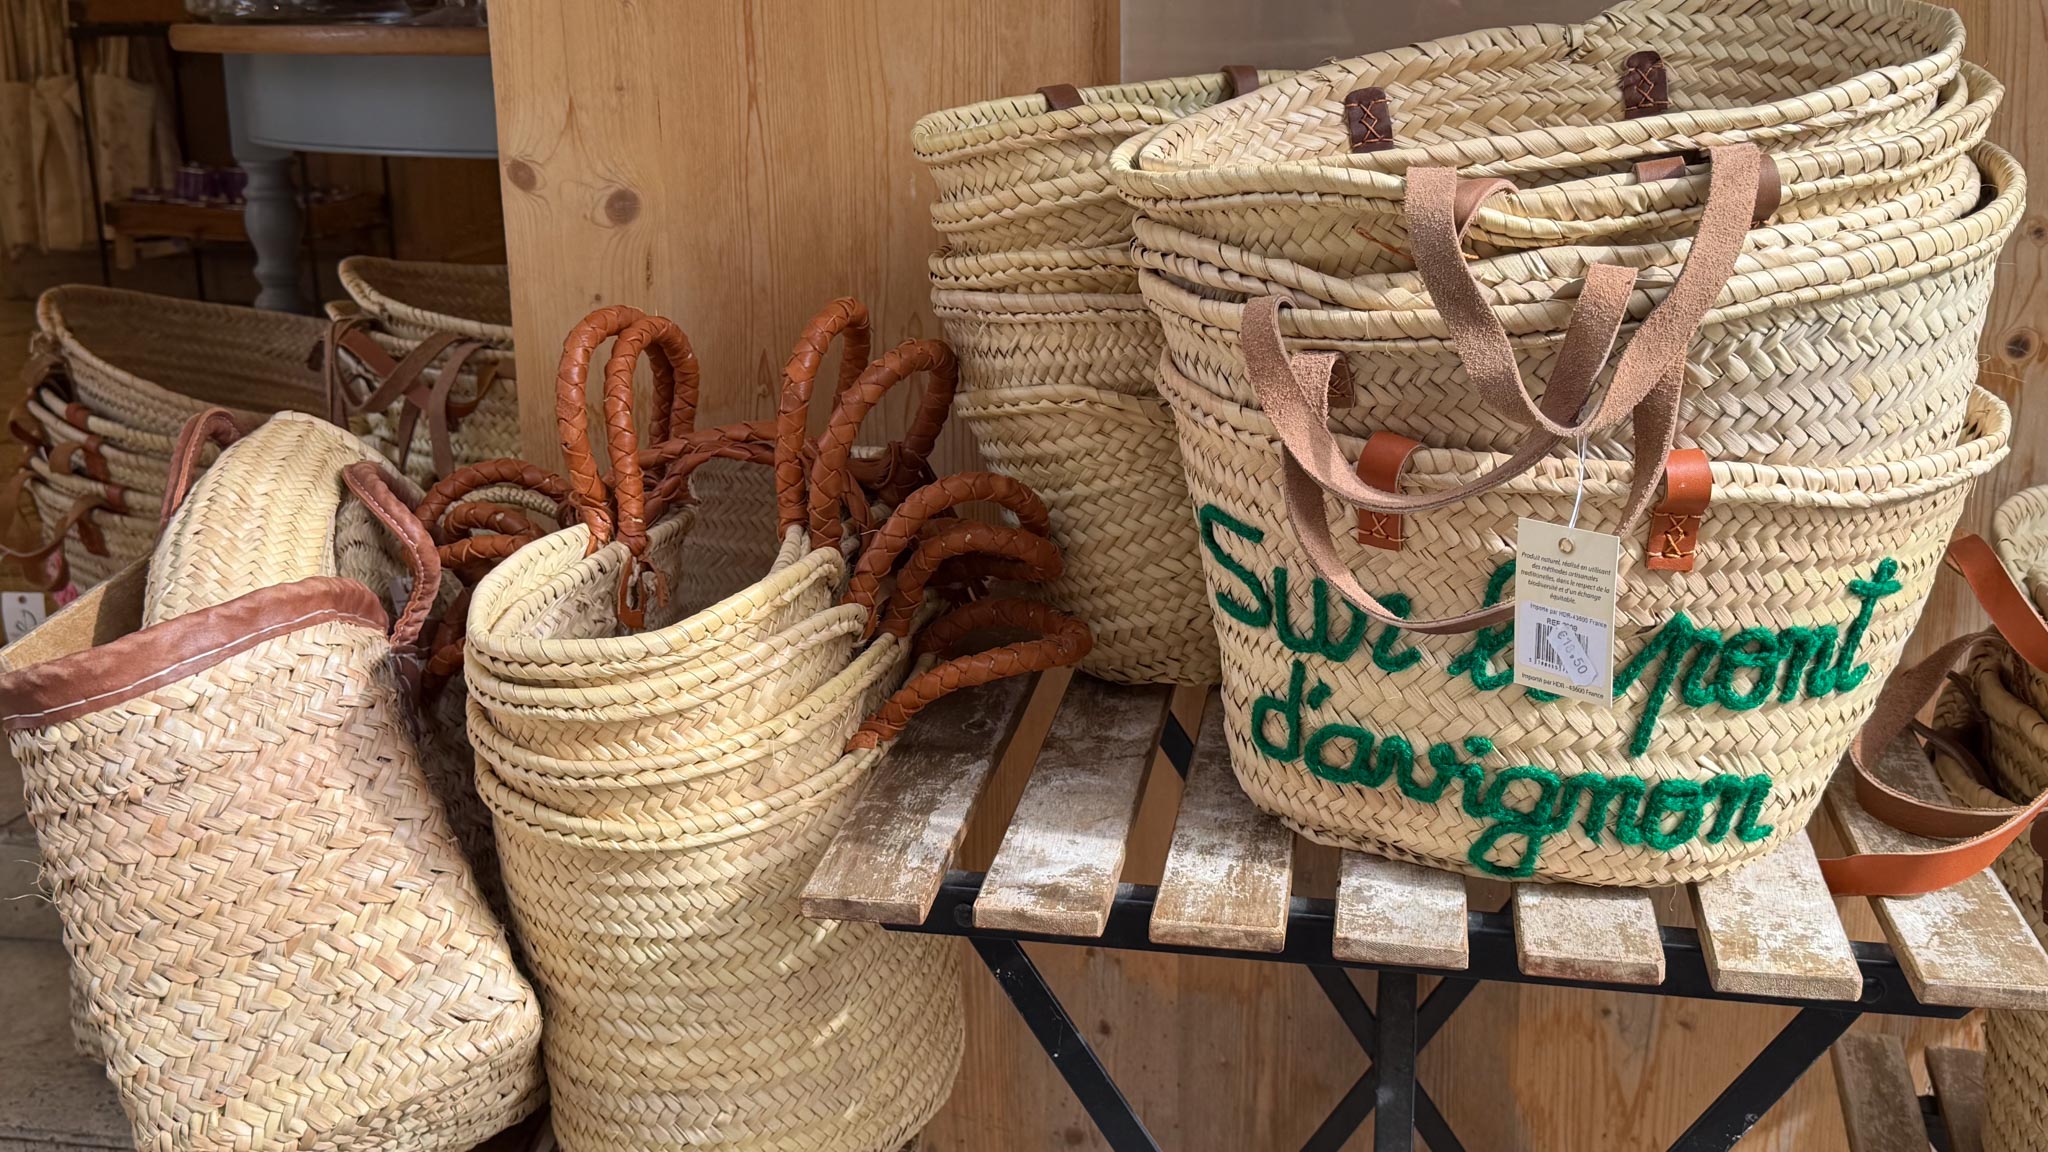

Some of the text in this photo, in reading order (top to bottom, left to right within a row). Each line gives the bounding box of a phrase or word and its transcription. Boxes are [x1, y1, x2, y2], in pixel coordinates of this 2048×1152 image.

[1521, 552, 1540, 561] Produit
[1541, 557, 1560, 566] naturel,
[1562, 560, 1579, 569] réalisé
[1588, 566, 1611, 576] utilisant
[1542, 566, 1568, 576] méthodes
[1568, 572, 1598, 582] artisanales
[1528, 580, 1558, 592] biodiversité
[1565, 588, 1577, 596] d'un
[1578, 591, 1602, 602] échange
[1556, 577, 1569, 585] dans
[1576, 582, 1596, 591] respect
[1550, 593, 1576, 604] équitable.
[1589, 618, 1607, 628] France
[1615, 555, 1902, 757] pont
[1585, 688, 1604, 699] France
[1250, 660, 1775, 878] d'avignon
